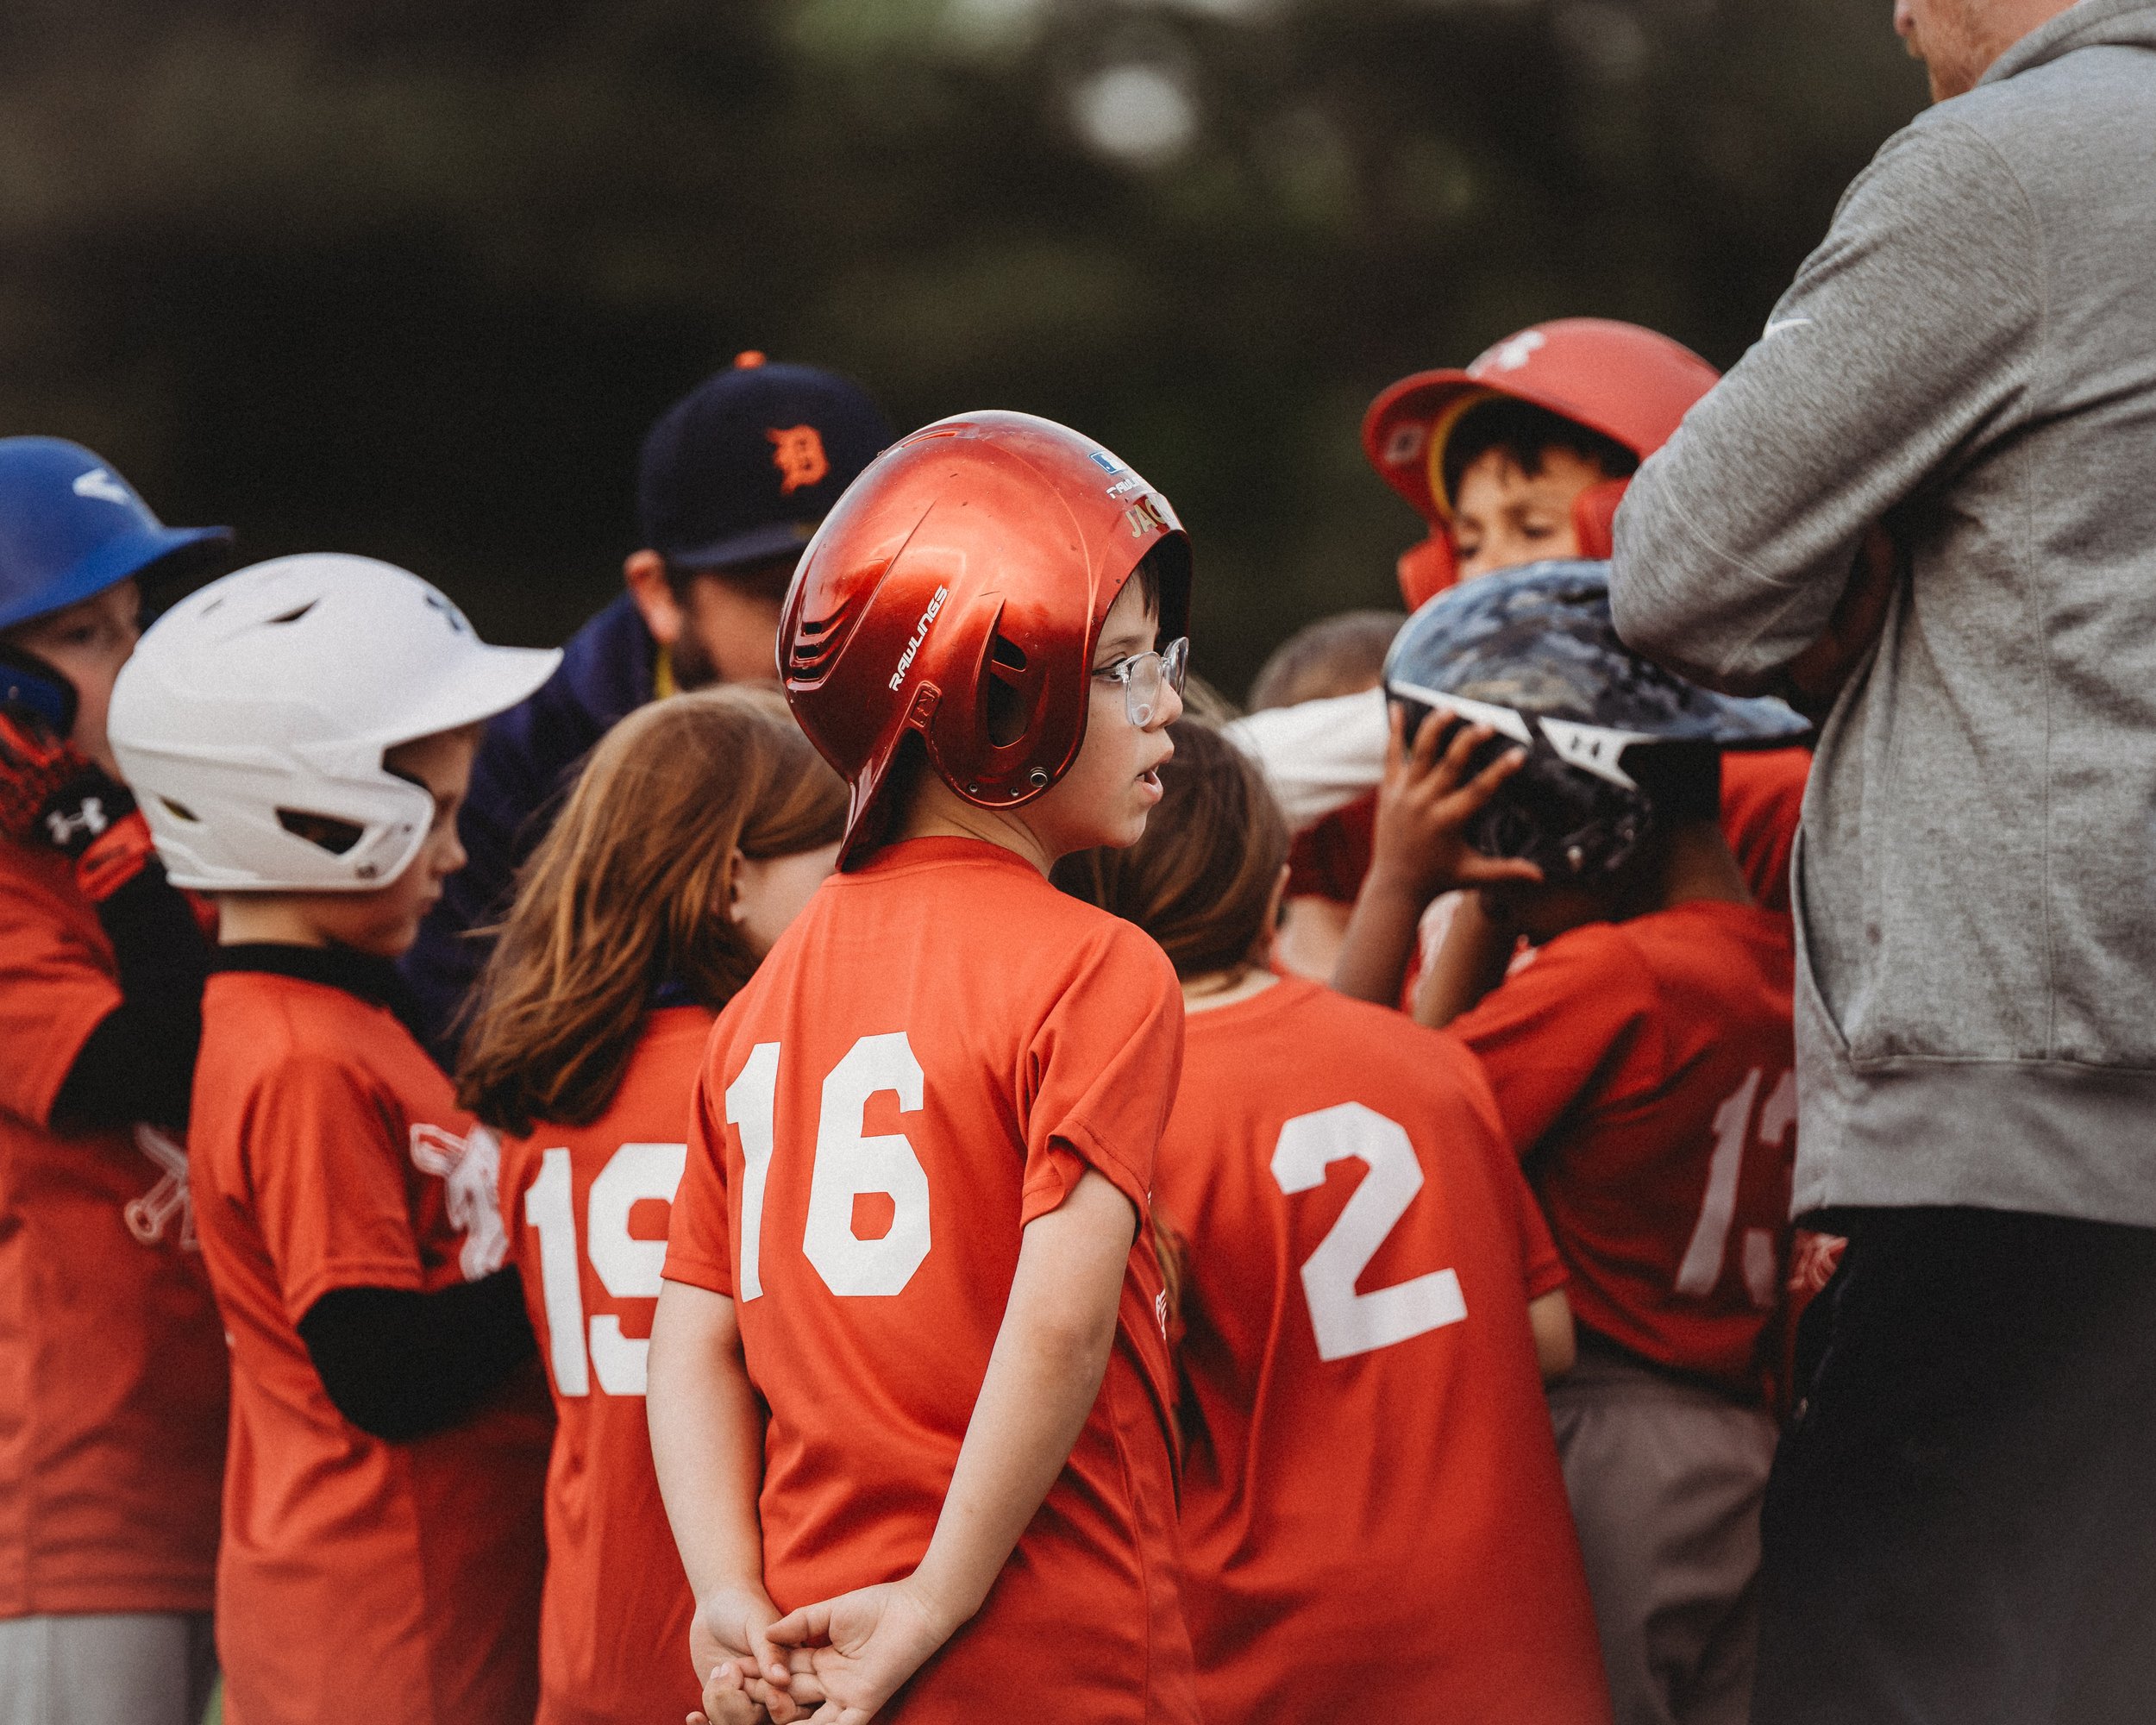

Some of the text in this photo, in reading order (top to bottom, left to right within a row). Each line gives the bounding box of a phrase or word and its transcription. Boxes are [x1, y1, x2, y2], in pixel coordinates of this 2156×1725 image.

[889, 584, 949, 691] RAWLINGS
[523, 1142, 688, 1396] 19
[725, 1031, 931, 1303] 16
[1270, 1101, 1467, 1362] 2
